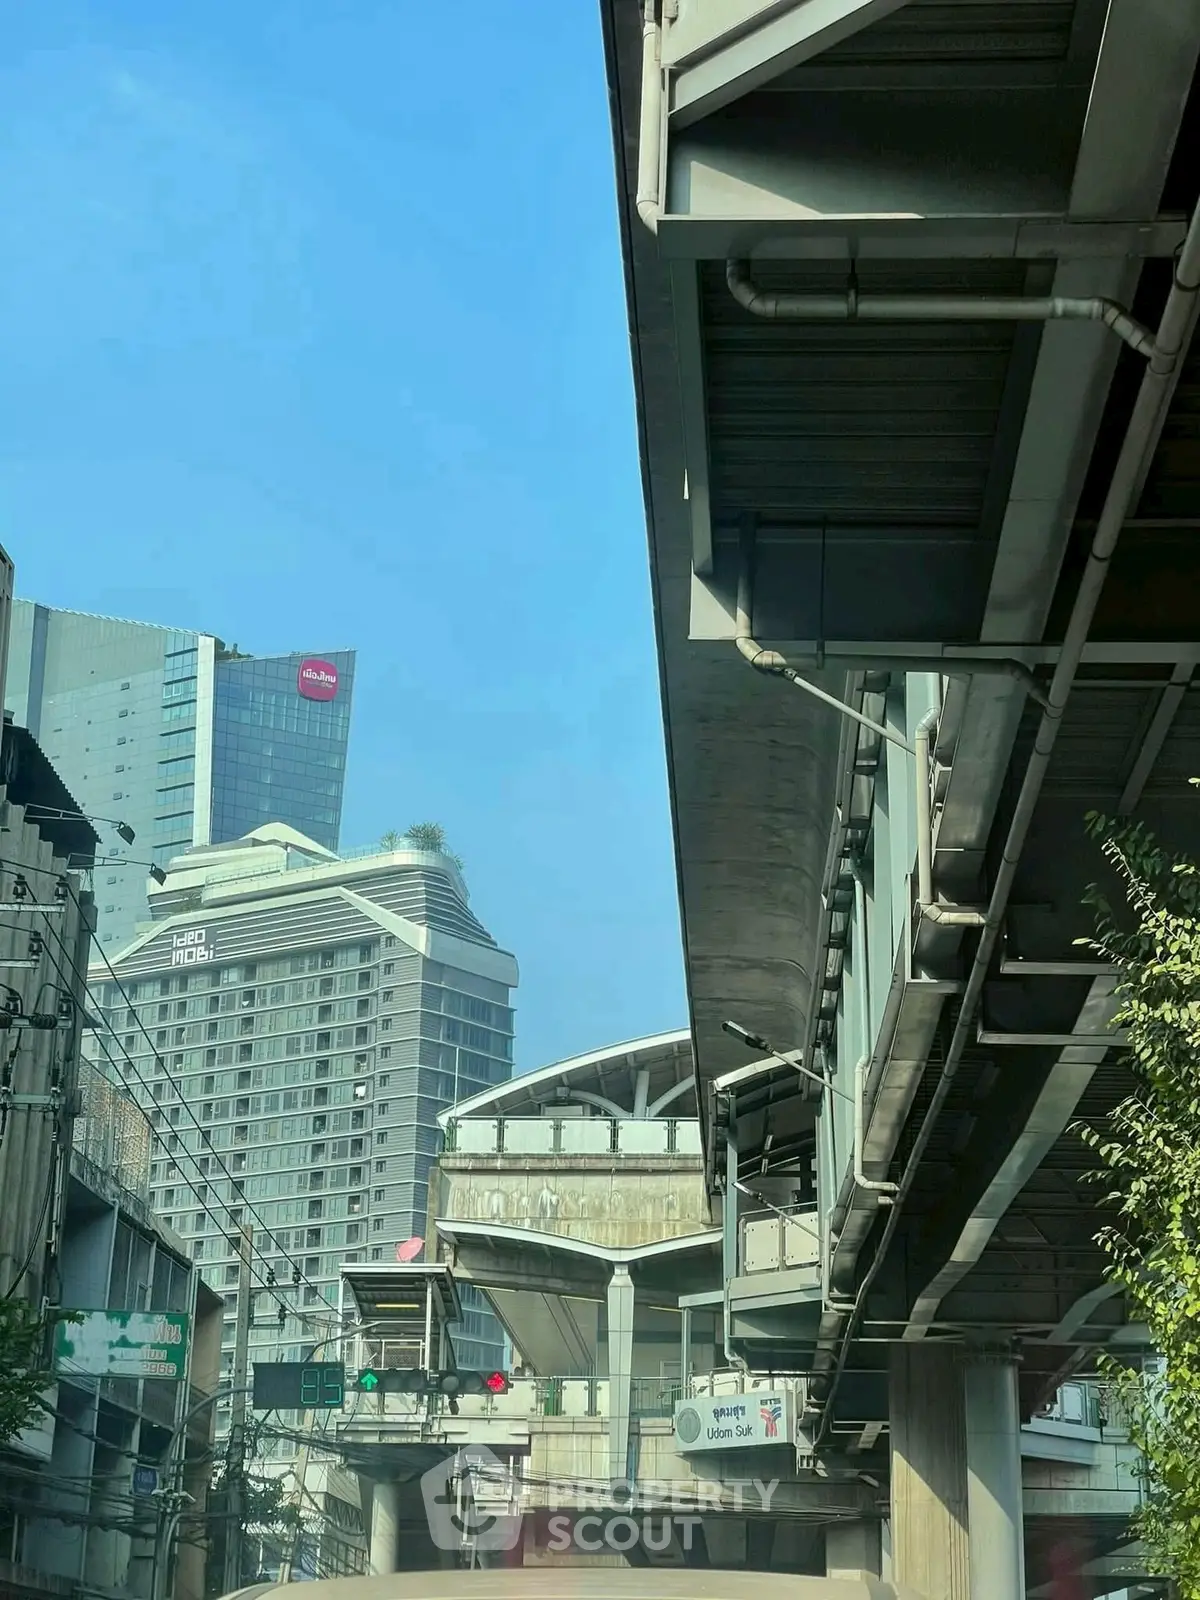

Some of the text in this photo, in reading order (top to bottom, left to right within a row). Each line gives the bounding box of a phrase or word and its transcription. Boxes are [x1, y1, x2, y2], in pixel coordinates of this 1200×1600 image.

[712, 1405, 746, 1423] อุดมสุข
[707, 1424, 753, 1440] Udom Suk
